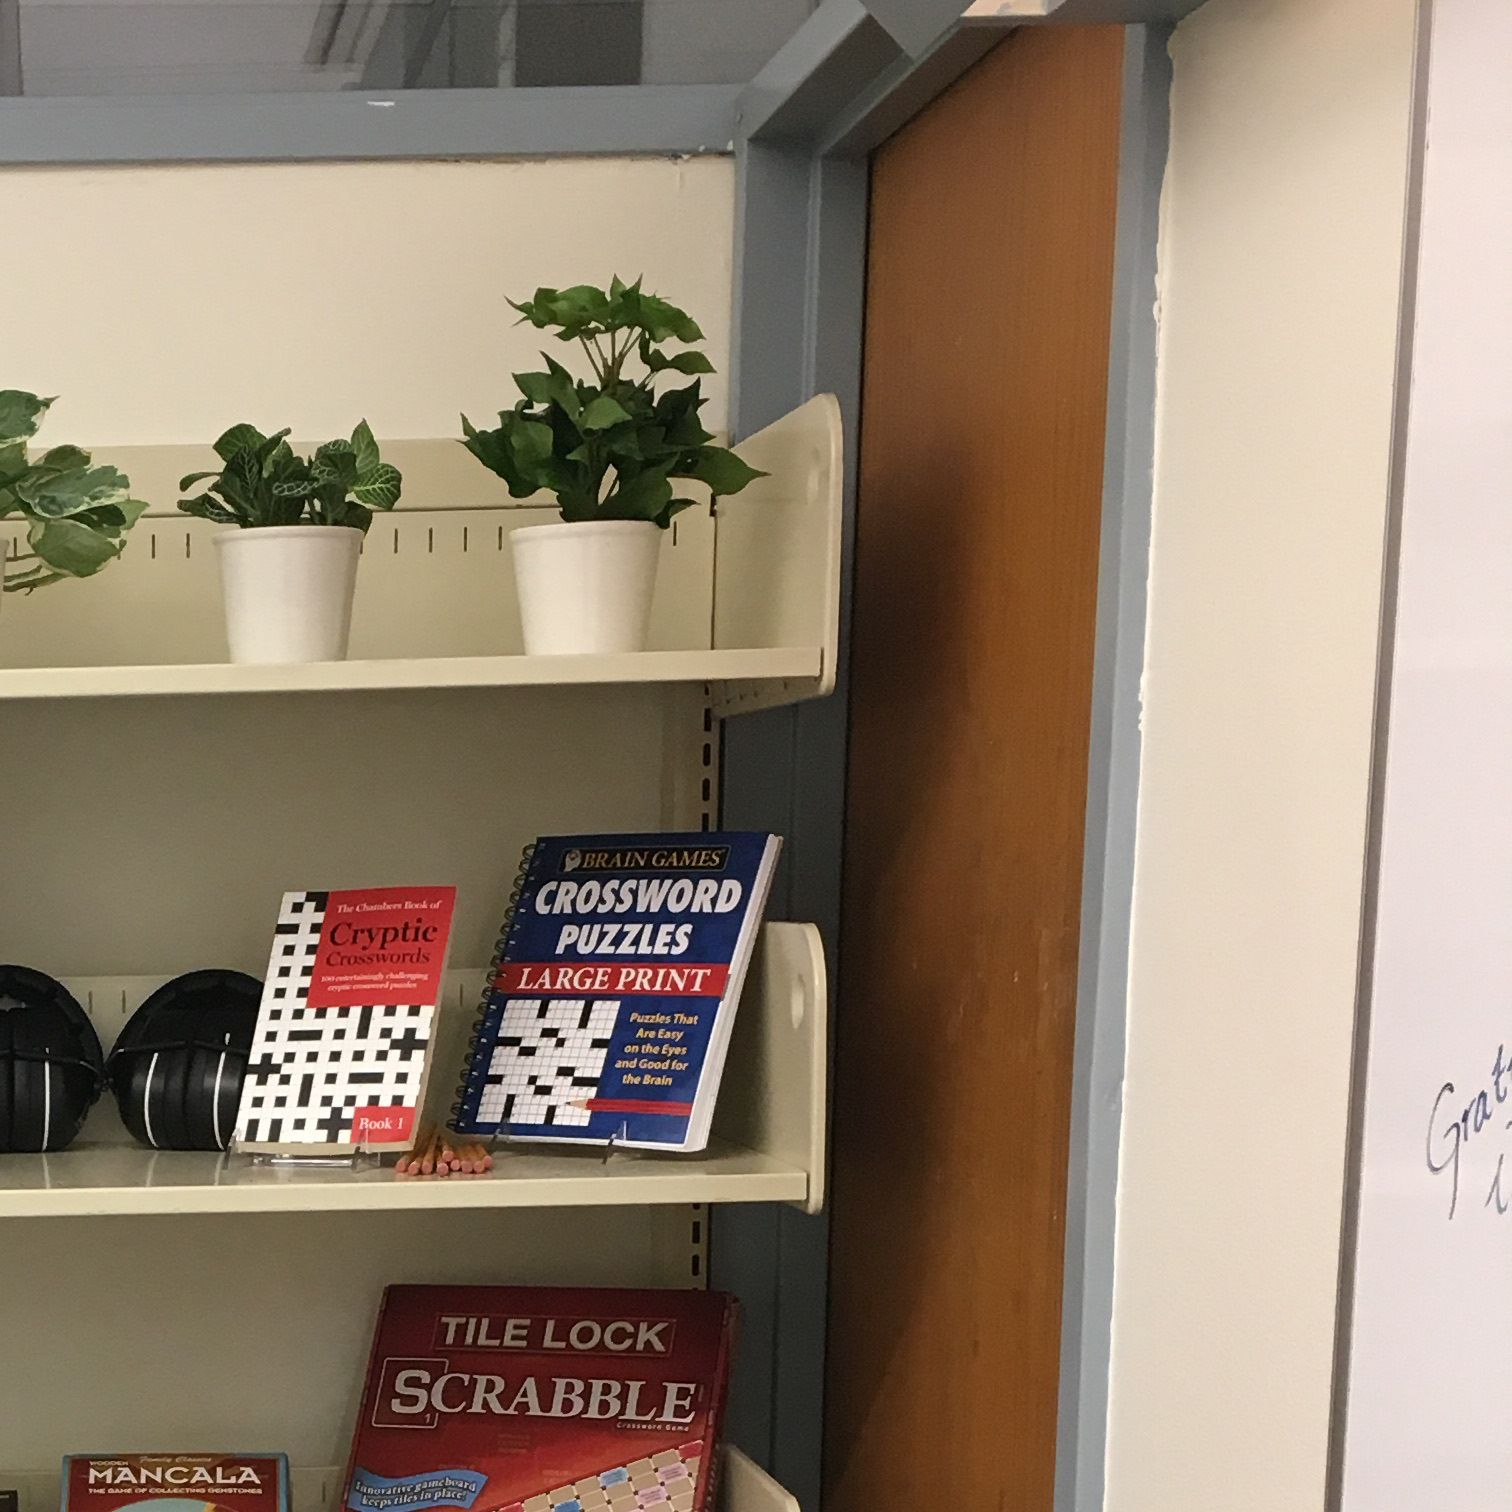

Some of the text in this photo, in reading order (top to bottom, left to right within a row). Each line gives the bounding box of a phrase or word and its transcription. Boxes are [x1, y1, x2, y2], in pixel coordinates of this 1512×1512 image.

[583, 849, 722, 868] BRAIN GAMES
[535, 878, 742, 914] CROSSWORD
[337, 900, 442, 913] The Chambers Book of
[329, 918, 438, 951] Cryptic
[555, 924, 694, 955] PUZZLES
[326, 948, 430, 966] Crosswords
[517, 967, 711, 992] LARGE PRINT
[630, 1012, 699, 1025] Puzzles That
[636, 1028, 684, 1042] Are Easy
[624, 1043, 687, 1057] on the Eyes
[615, 1058, 688, 1071] and Good for
[622, 1074, 673, 1086] the Brain
[359, 1117, 392, 1130] Book
[440, 1317, 670, 1353] TILE LOCK
[391, 1370, 696, 1424] SCRABBLE
[89, 1467, 261, 1484] MANCALA
[414, 1477, 476, 1493] gameboard
